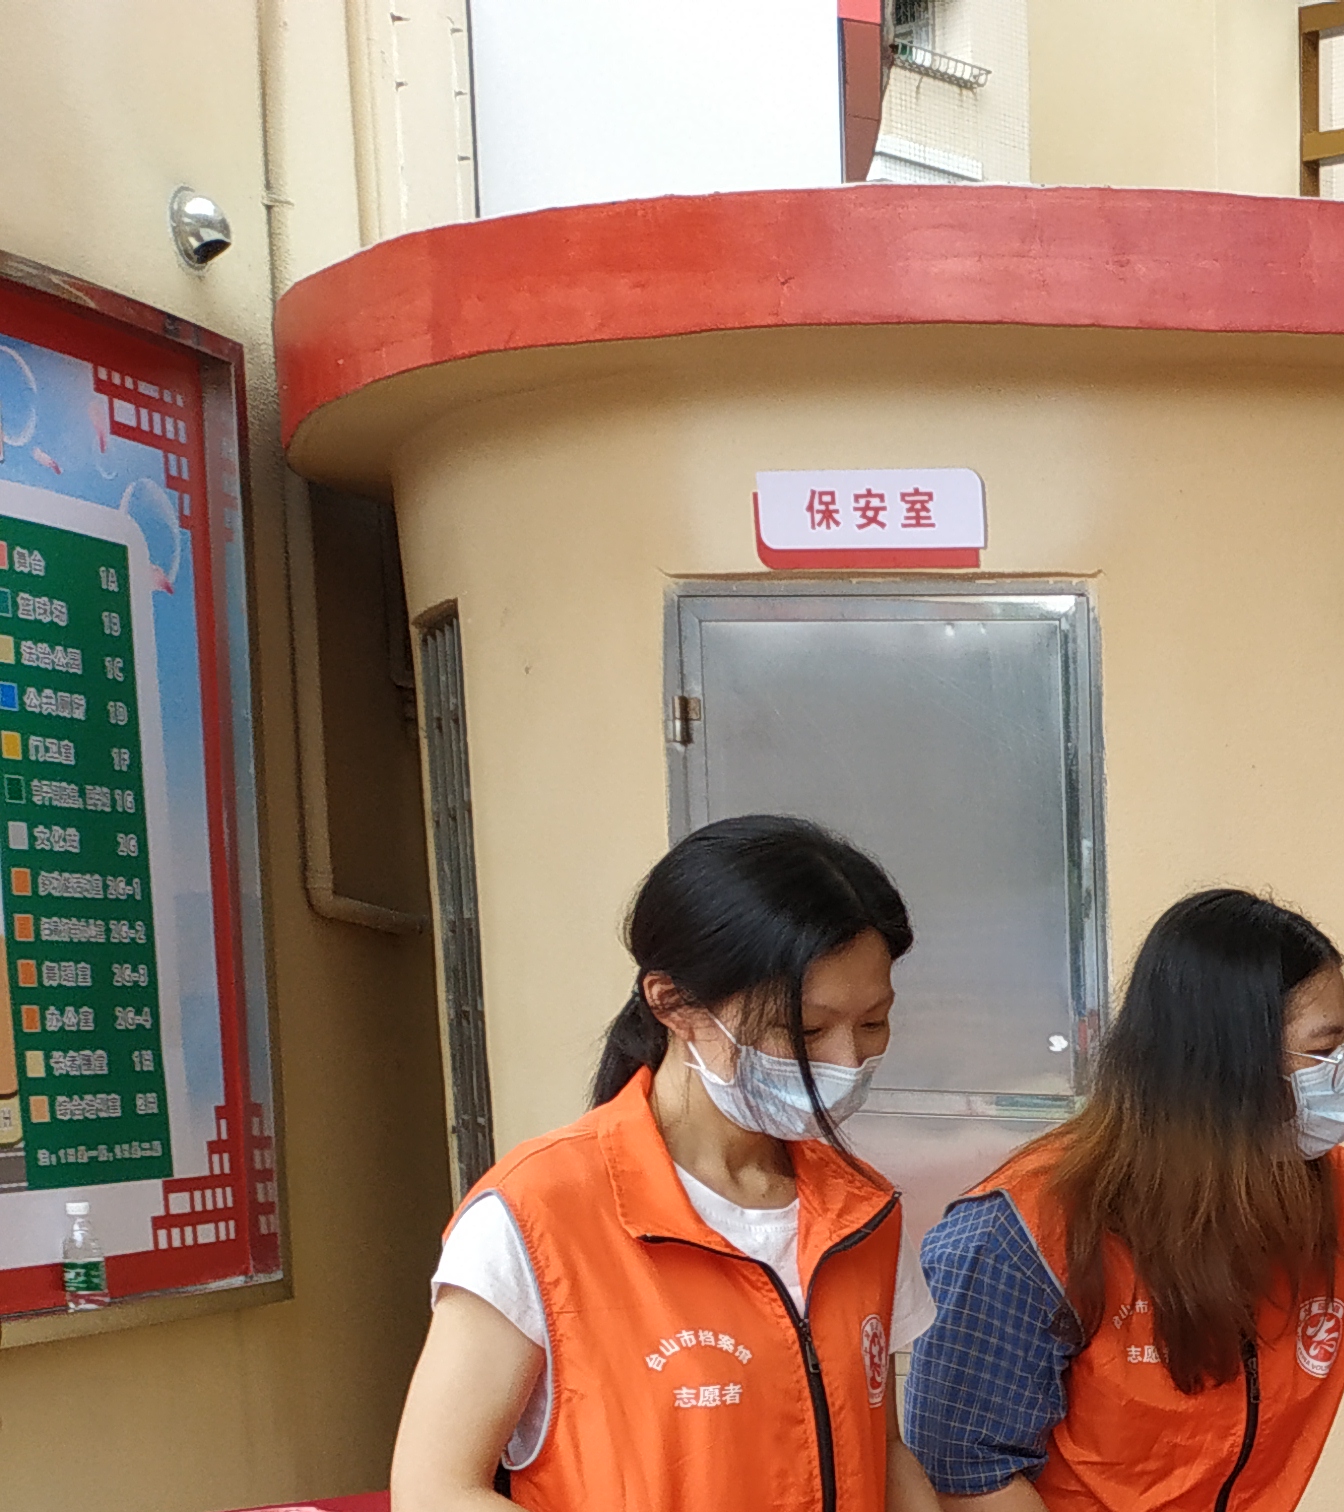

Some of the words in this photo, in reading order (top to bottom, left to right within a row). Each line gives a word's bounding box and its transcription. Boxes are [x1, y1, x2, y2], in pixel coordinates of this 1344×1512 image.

[805, 487, 936, 530] 保安室
[99, 566, 119, 592] 1A
[102, 611, 121, 636] 1B
[104, 656, 124, 682] 1C
[29, 735, 75, 765] 门卫室
[45, 1006, 94, 1031] 办公室
[646, 1329, 753, 1372] 台山市档案馆
[673, 1382, 743, 1408] 志愿者
